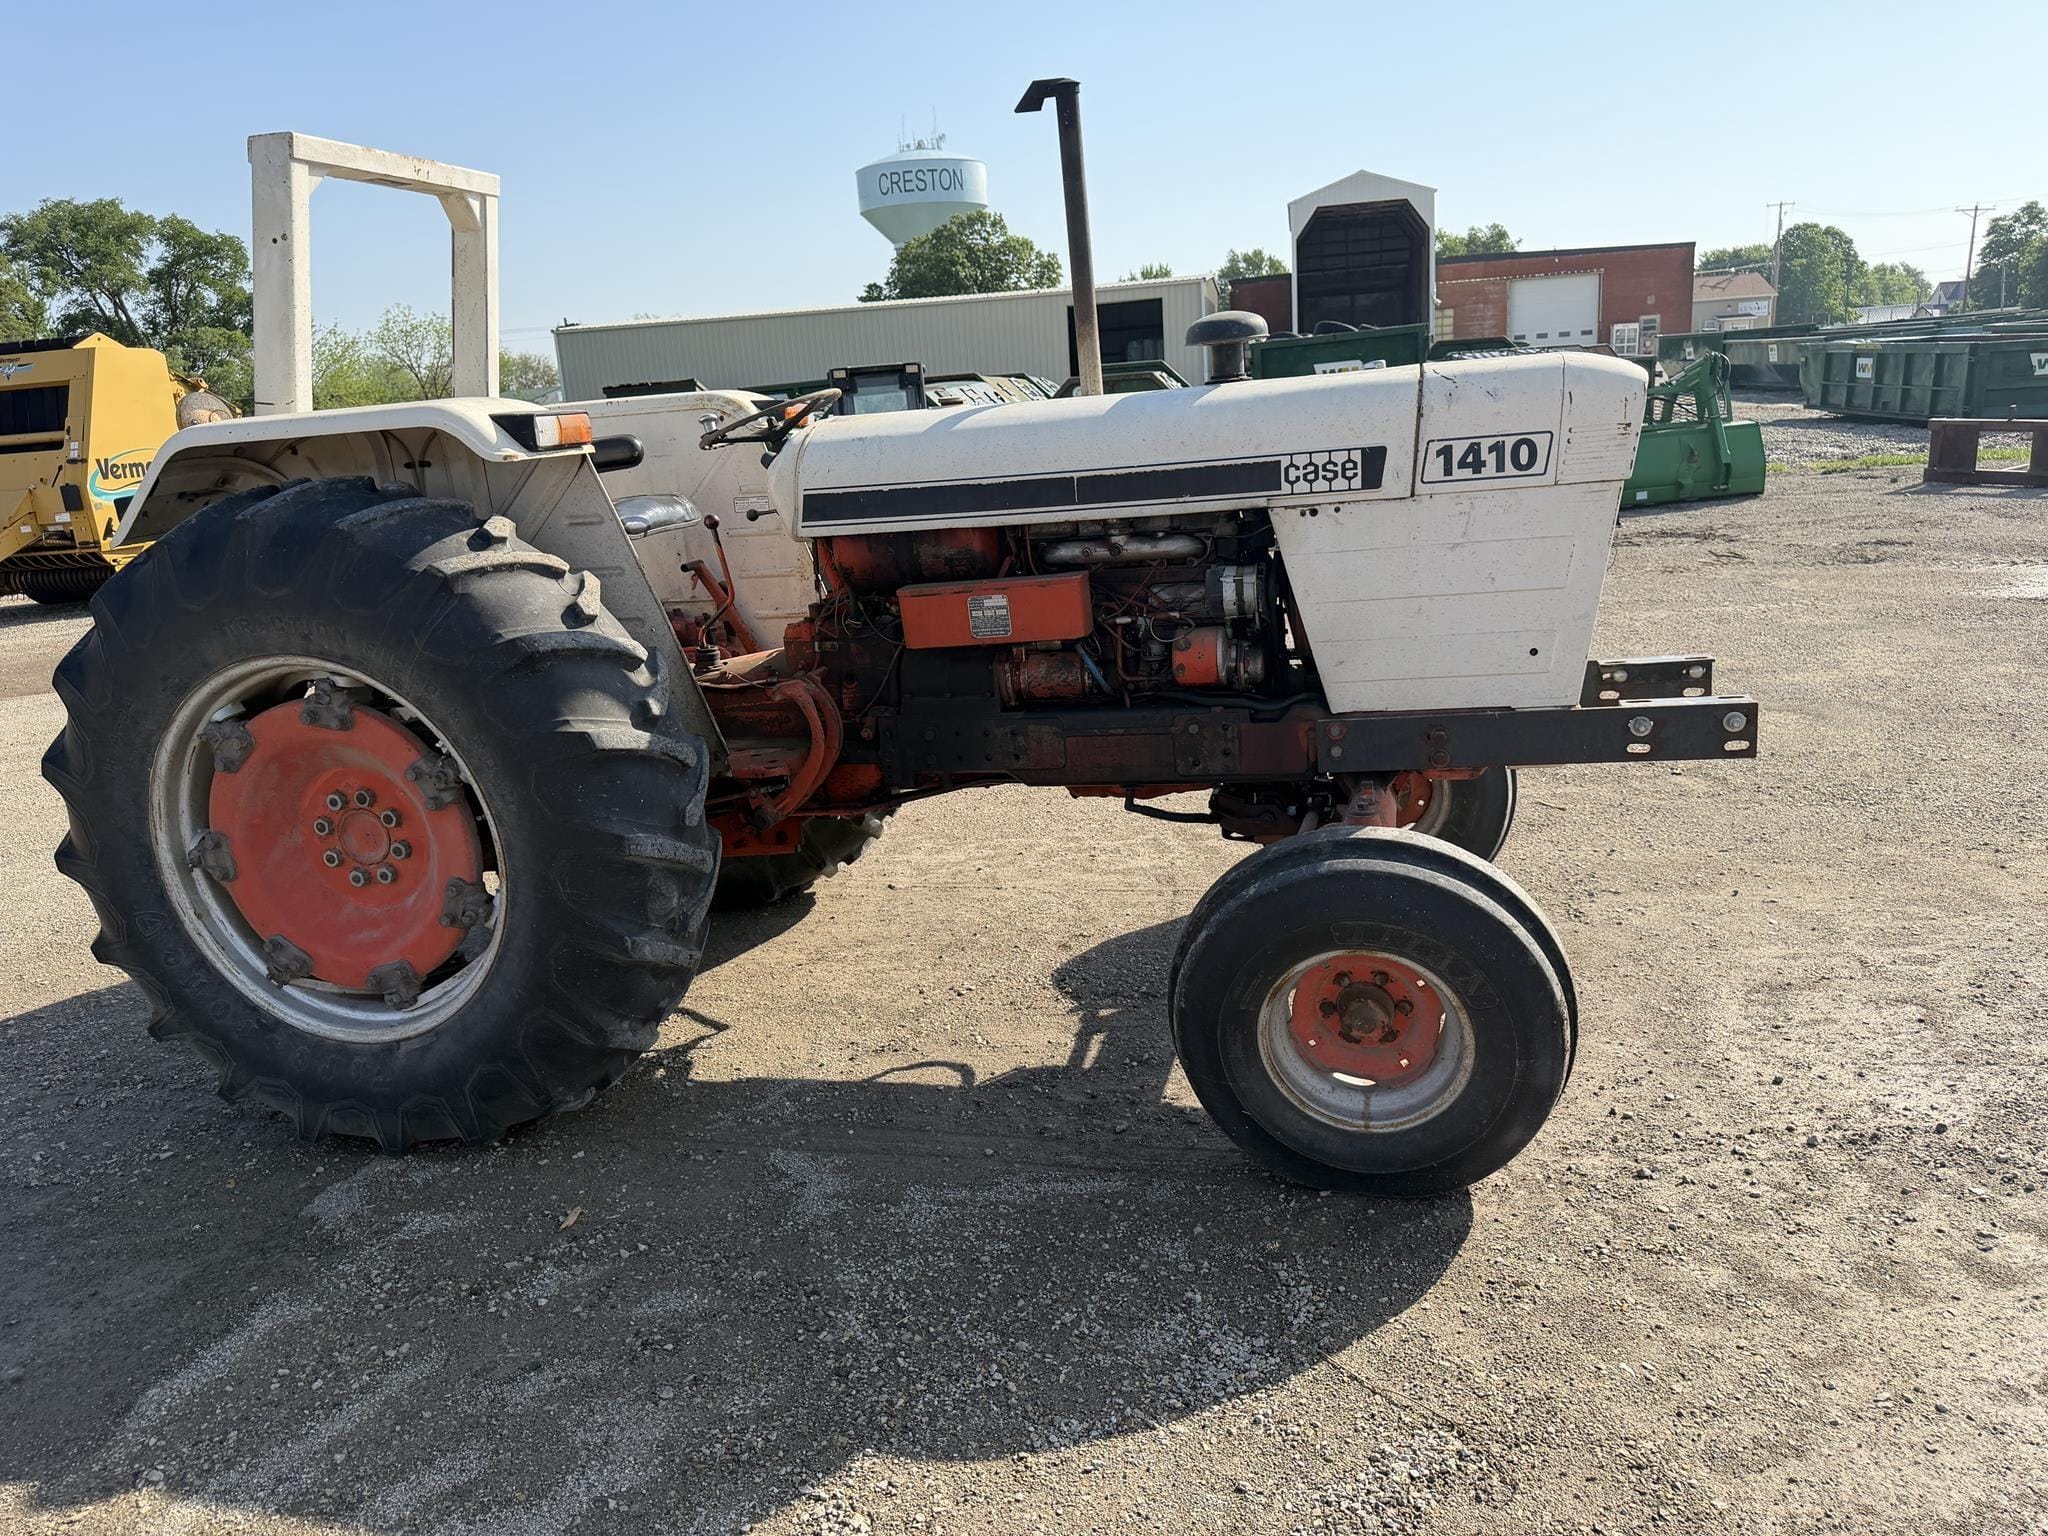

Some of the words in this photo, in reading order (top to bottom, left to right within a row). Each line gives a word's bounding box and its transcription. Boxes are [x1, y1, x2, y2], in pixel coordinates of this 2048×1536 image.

[878, 168, 964, 196] CRESTON
[1284, 456, 1359, 487] case
[1435, 437, 1538, 477] 1410
